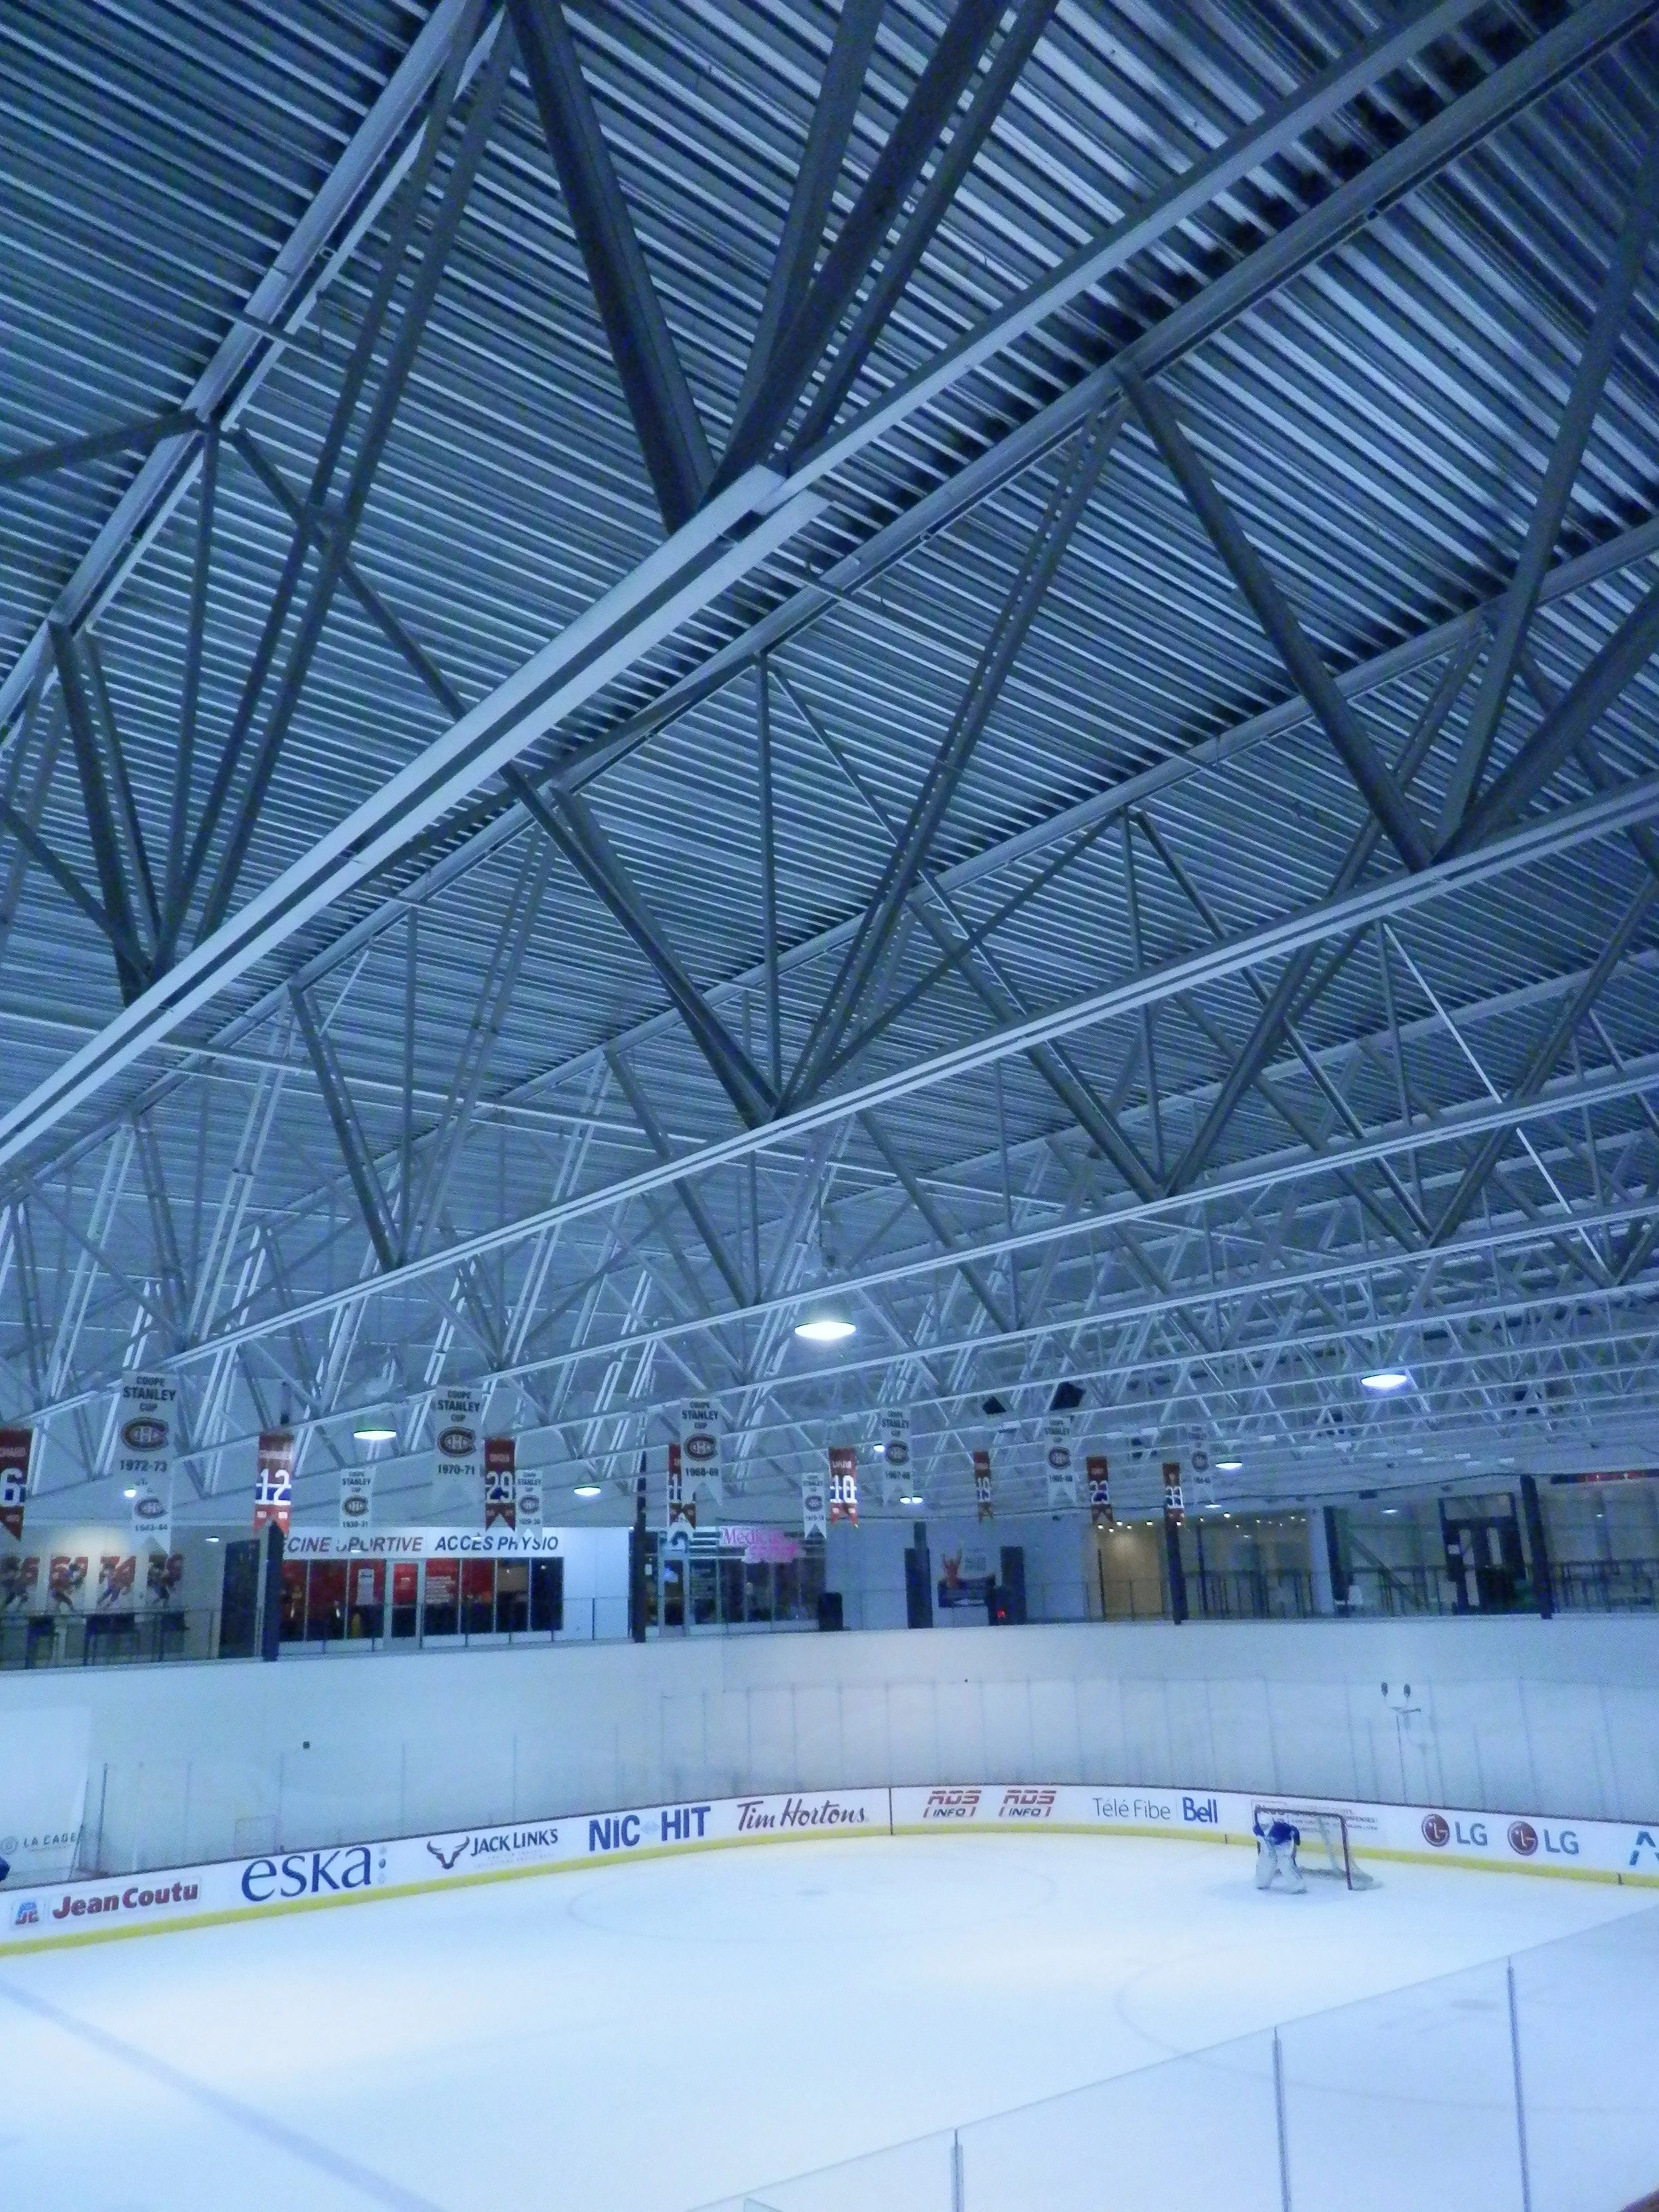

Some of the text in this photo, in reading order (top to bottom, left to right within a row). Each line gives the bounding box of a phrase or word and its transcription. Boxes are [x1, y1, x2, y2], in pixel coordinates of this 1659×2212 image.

[123, 1386, 177, 1401] STANLEY
[438, 1399, 480, 1412] STANLEY
[682, 1409, 718, 1420] STANLEY
[120, 1459, 167, 1473] 1972-73
[438, 1464, 475, 1475] 1970-71
[259, 1468, 290, 1505] 12
[486, 1471, 513, 1503] 29
[832, 1475, 856, 1503] 10
[284, 1536, 332, 1553] CINE
[498, 1536, 559, 1550] PHYSIO
[737, 1797, 865, 1831] Tim Hortons
[932, 1808, 966, 1817] INFO
[1008, 1808, 1041, 1817] INFO
[1092, 1798, 1171, 1820] Télé Fibe
[1182, 1797, 1218, 1823] Bell
[661, 1806, 711, 1842] HIT
[1455, 1821, 1488, 1846] LG
[23, 1836, 38, 1848] LA
[470, 1834, 511, 1857] JACK
[513, 1828, 558, 1849] LINK'S
[1544, 1828, 1579, 1855] LG
[242, 1846, 371, 1901] eska
[52, 1881, 198, 1919] Jean Coutu
